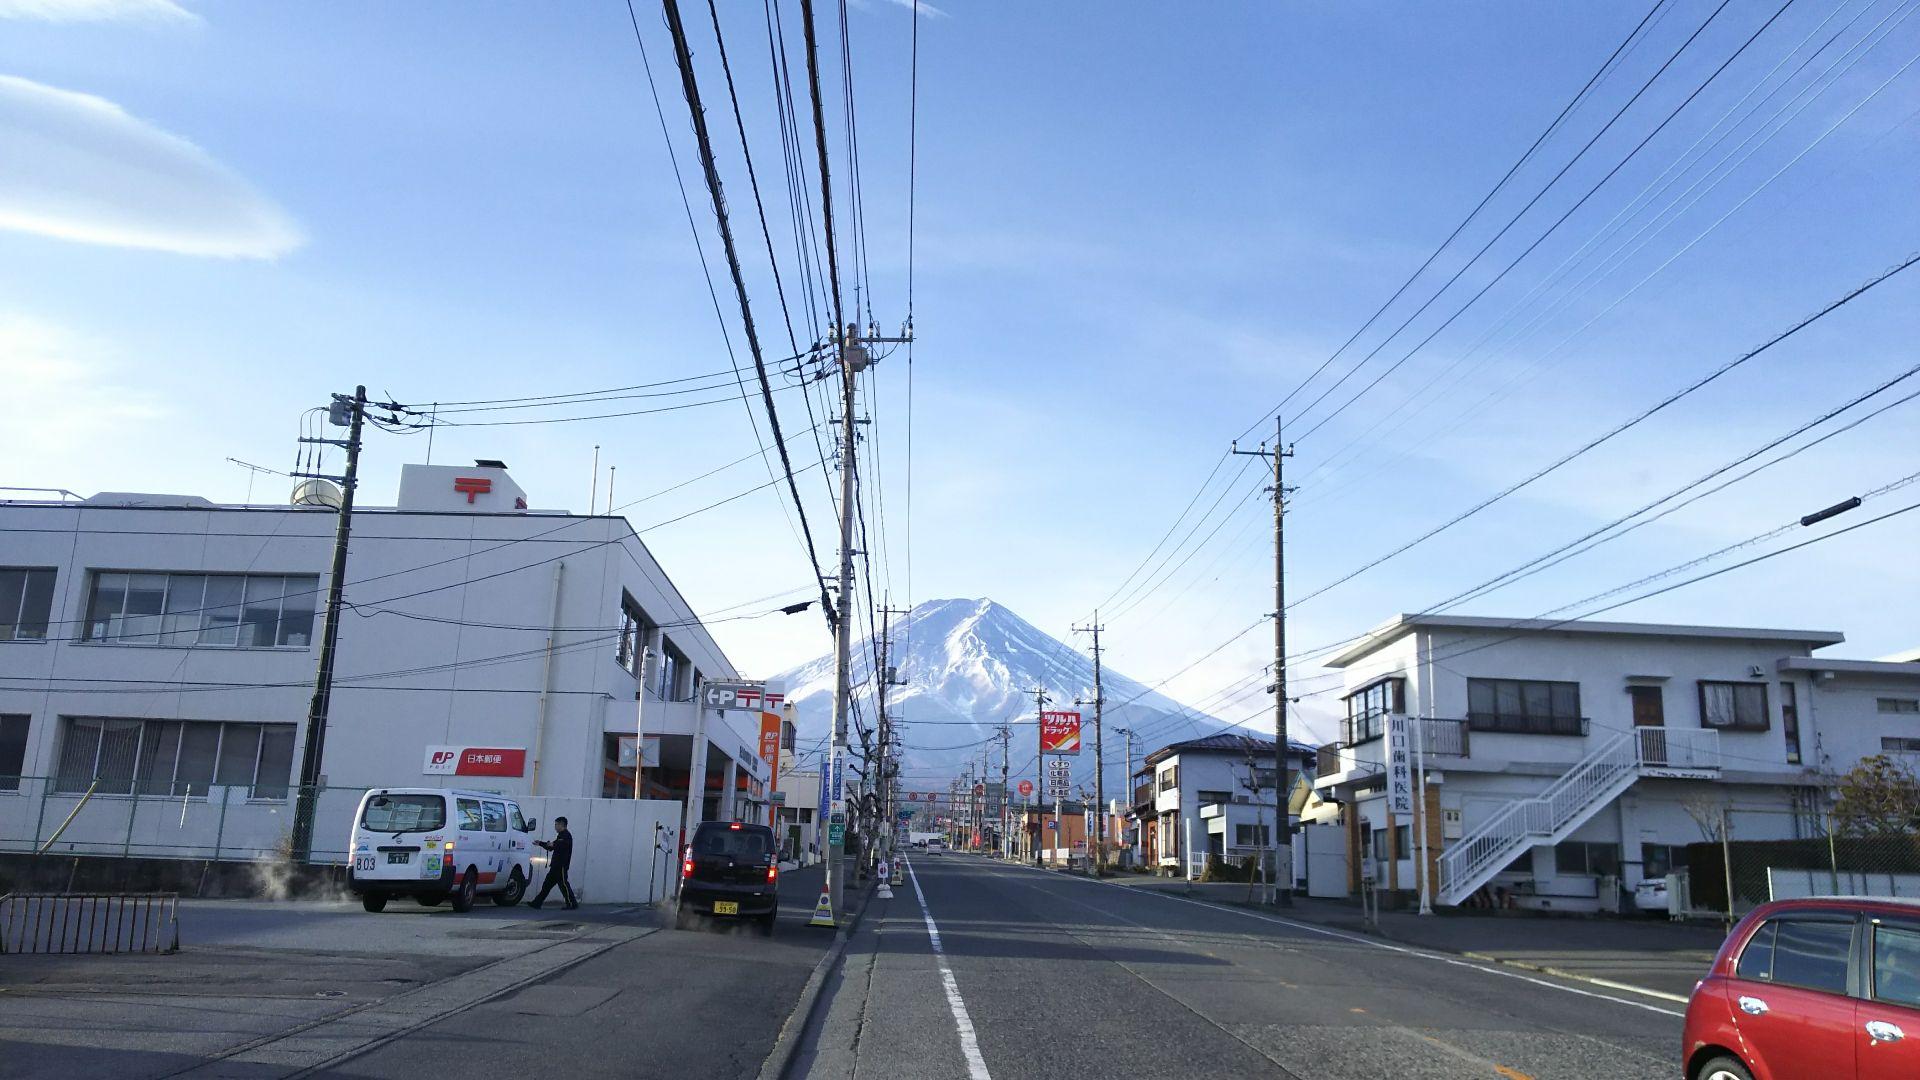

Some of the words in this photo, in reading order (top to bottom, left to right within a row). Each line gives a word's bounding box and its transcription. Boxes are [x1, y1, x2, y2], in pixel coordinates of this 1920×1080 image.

[719, 690, 735, 705] P
[1044, 714, 1078, 726] ツルハ
[431, 751, 455, 765] JP
[467, 754, 502, 764] 日本郵便
[1391, 719, 1410, 810] 川口歯科医院
